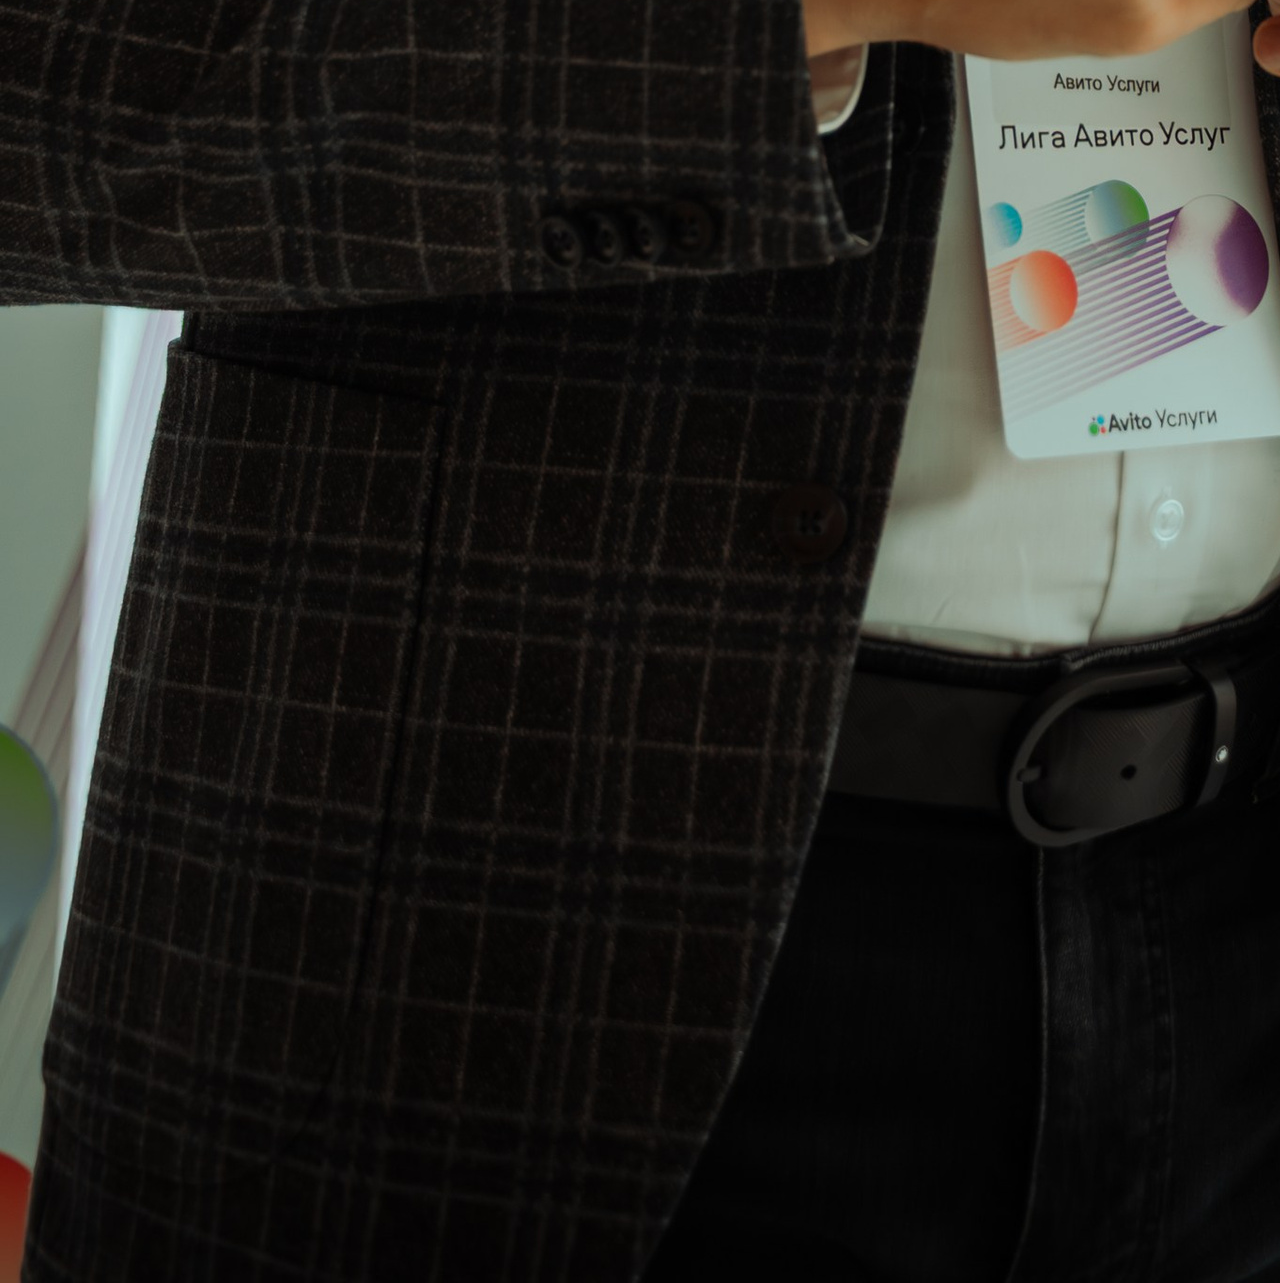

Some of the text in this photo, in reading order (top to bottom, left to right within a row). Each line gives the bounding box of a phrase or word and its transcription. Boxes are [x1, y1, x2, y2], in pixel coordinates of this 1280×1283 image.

[1054, 73, 1160, 96] Авито Услуги
[999, 121, 1230, 151] Лига Авито Услуг
[1108, 408, 1218, 433] Avito Услуги
